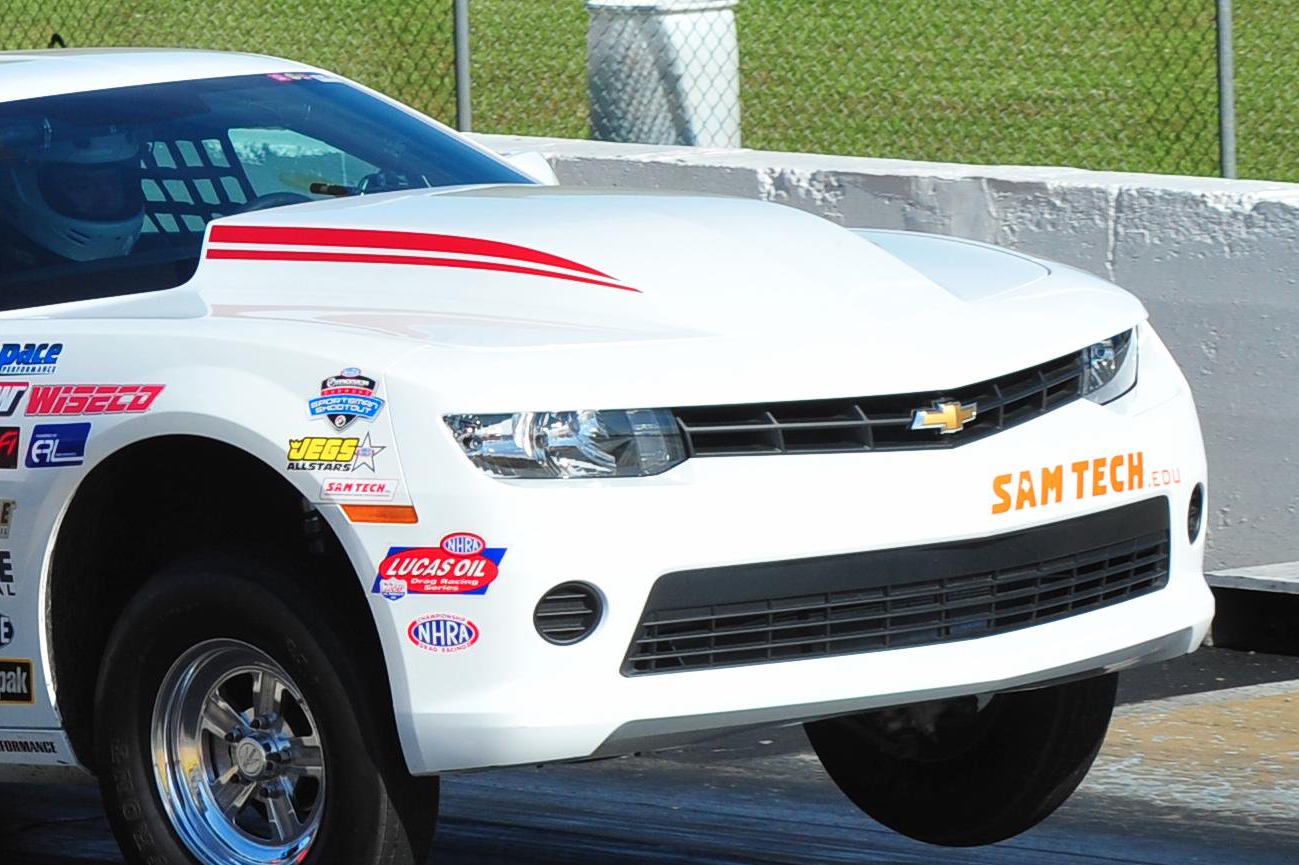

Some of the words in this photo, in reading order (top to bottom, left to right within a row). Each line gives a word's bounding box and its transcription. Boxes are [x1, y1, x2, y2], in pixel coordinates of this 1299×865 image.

[287, 436, 360, 462] JEGS
[287, 462, 352, 472] ALLSTARS
[326, 482, 353, 492] SAM
[355, 483, 386, 493] TECH
[991, 464, 1064, 514] SAM
[1072, 451, 1144, 499] TECH
[446, 536, 481, 553] NHRA
[386, 557, 455, 577] LUCAS
[454, 558, 487, 577] OIL
[410, 578, 438, 586] Drag
[441, 578, 480, 587] Racing
[423, 584, 460, 592] Series
[417, 620, 471, 646] NHRA
